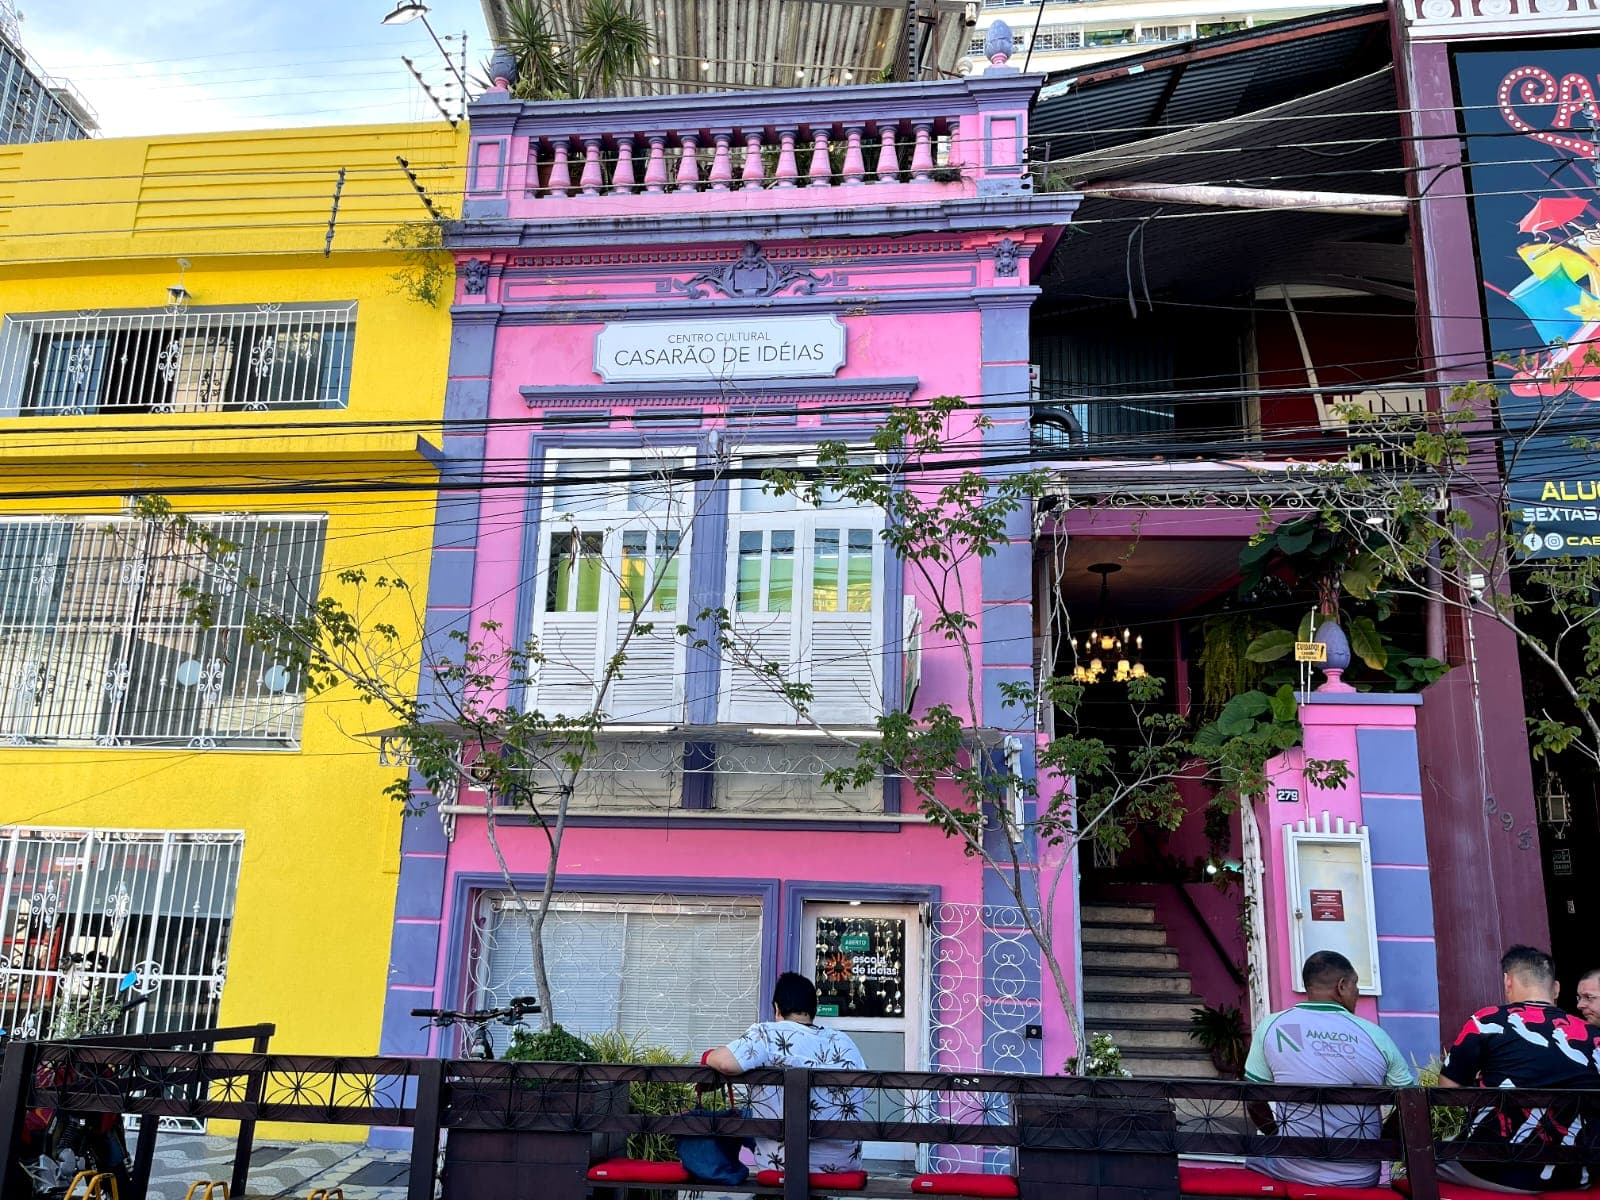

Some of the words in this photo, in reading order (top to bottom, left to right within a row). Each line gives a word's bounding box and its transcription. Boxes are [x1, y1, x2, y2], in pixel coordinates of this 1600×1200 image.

[667, 333, 714, 344] CENTRO
[716, 331, 772, 342] CULTURAL
[614, 345, 716, 366] CASARÃO
[722, 347, 750, 363] DE
[757, 342, 825, 362] IDÉIAS
[1540, 480, 1600, 501] ALU
[1277, 790, 1298, 801] 279
[852, 954, 887, 964] escola
[852, 964, 866, 975] de
[1305, 1029, 1359, 1044] AMAZON
[1311, 1041, 1356, 1054] CRETO
